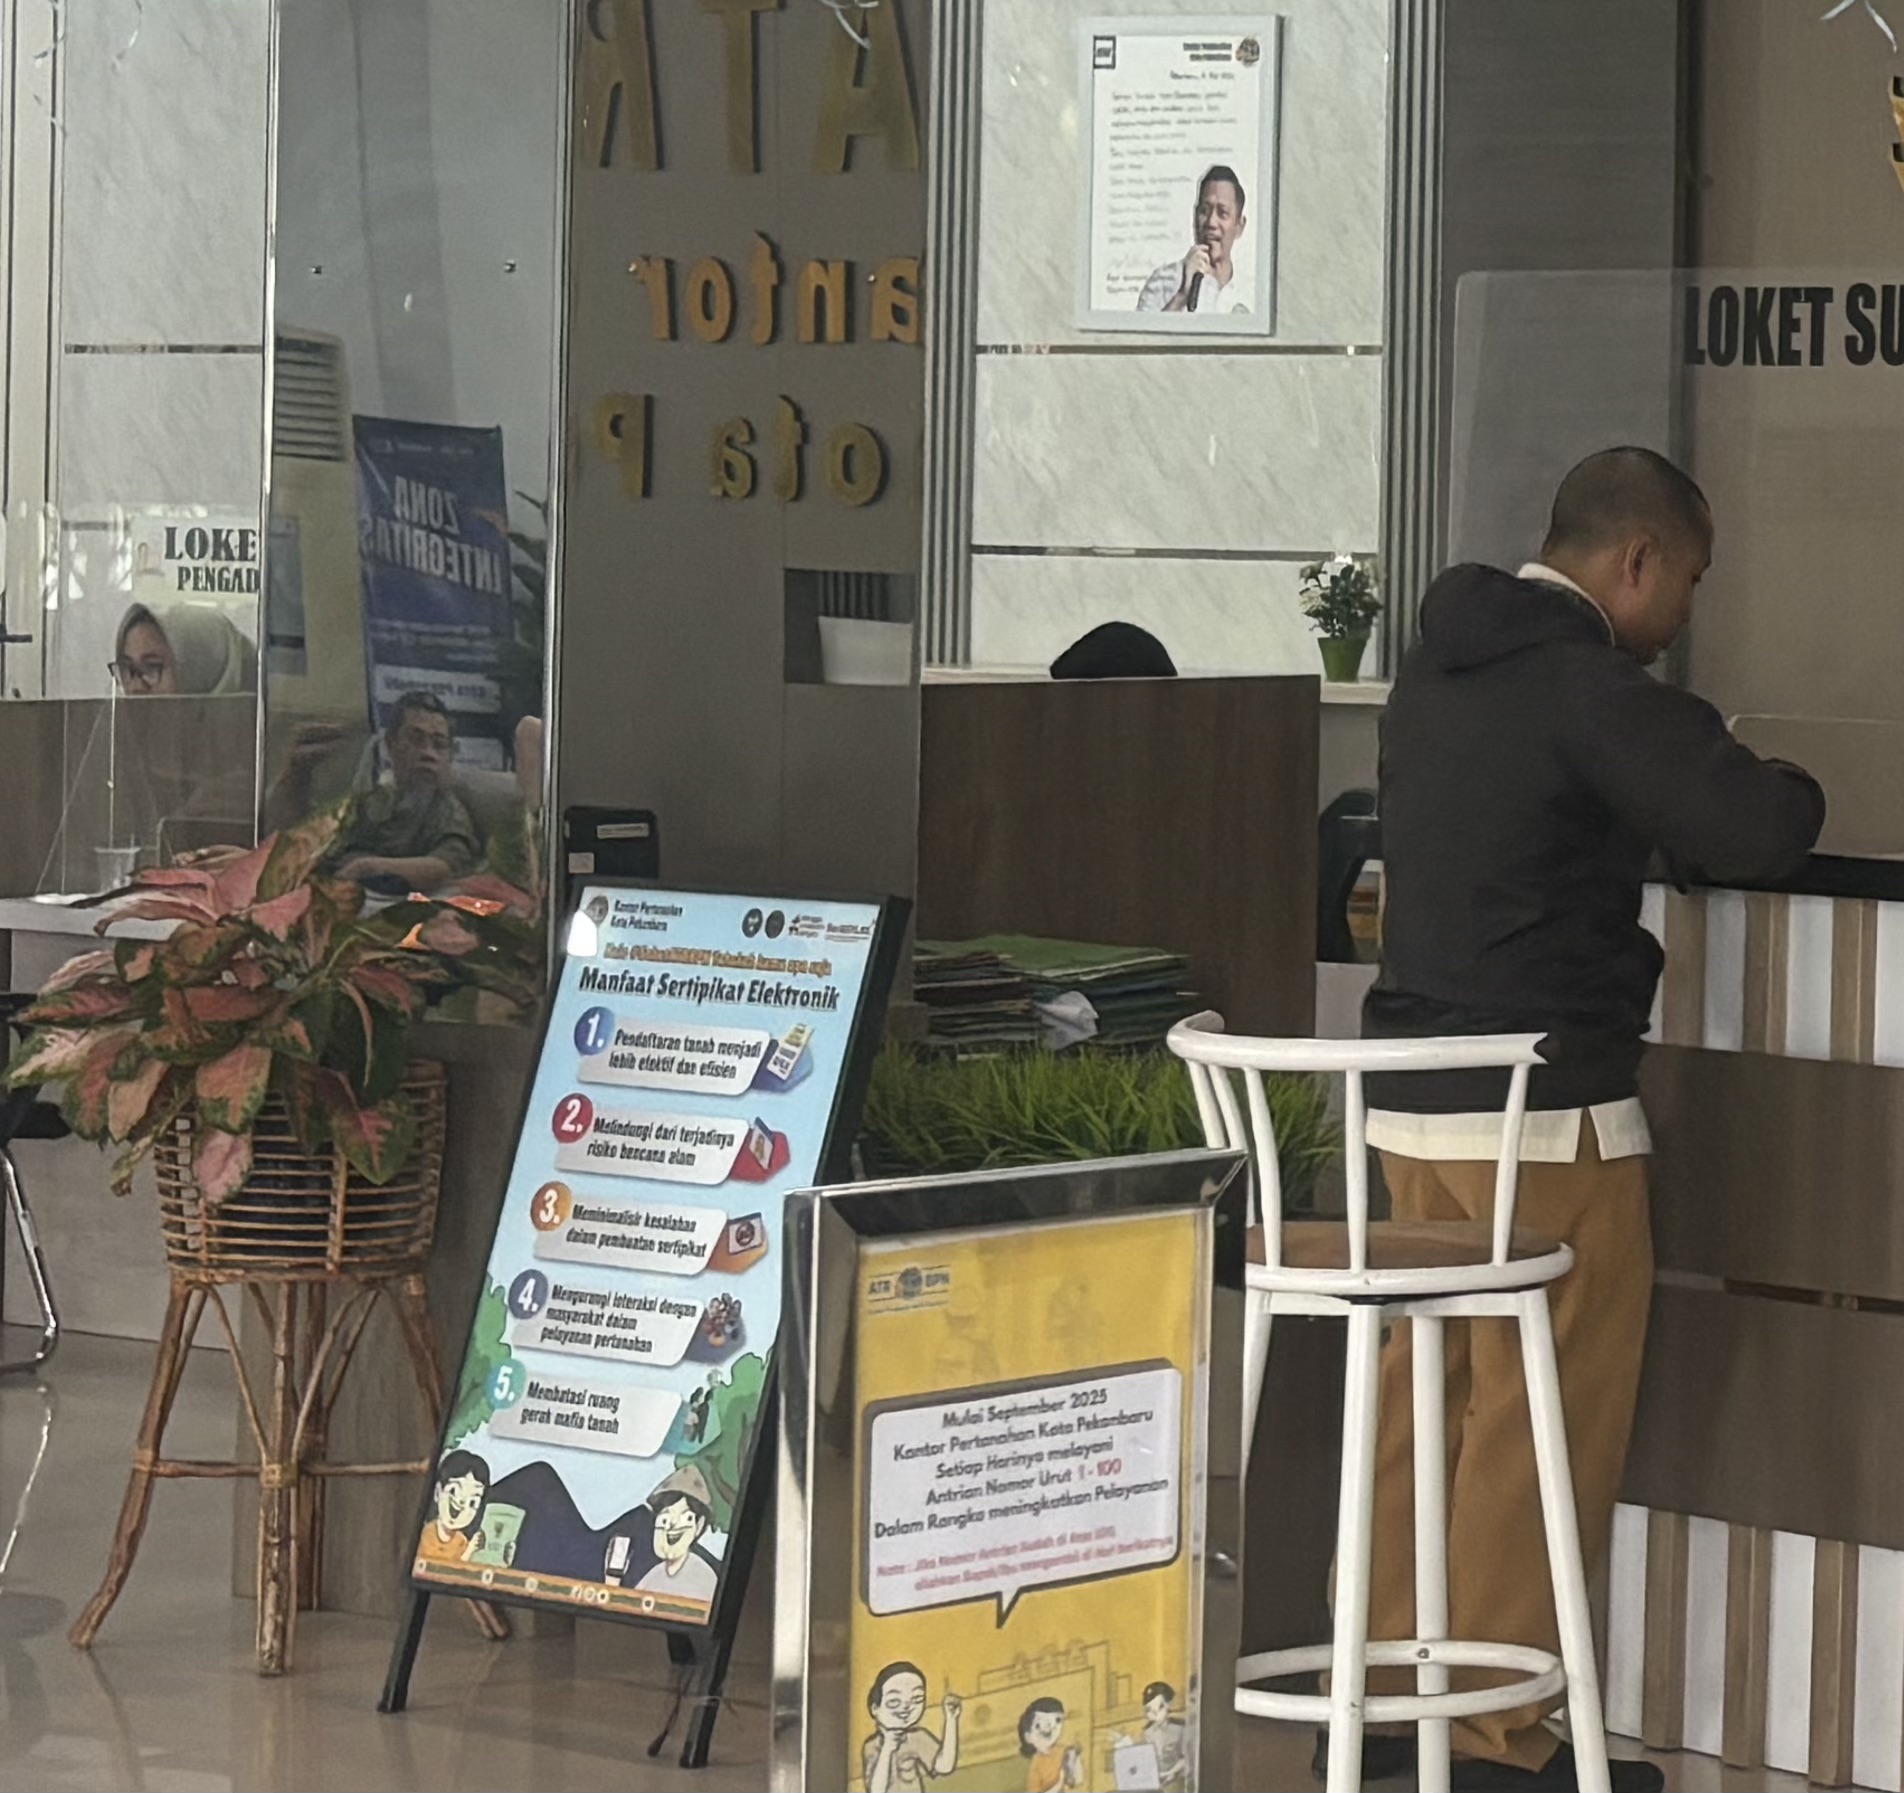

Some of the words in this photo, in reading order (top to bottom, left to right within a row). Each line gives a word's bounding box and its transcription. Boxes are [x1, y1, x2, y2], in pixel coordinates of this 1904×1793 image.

[1685, 285, 1833, 367] LOKET
[580, 966, 654, 994] Manfaat
[657, 972, 744, 1006] Sertipikat
[748, 979, 840, 1009] Elektronik
[585, 1012, 605, 1047] 1.
[614, 1029, 681, 1050] Pendaftaran
[942, 1411, 984, 1428] Mulai
[987, 1398, 1066, 1421] September
[1070, 1388, 1108, 1406] 2025
[894, 1441, 945, 1461] Kantor
[950, 1428, 1034, 1452] Pertanahan
[1077, 1410, 1153, 1432] Pekanbaru
[875, 1520, 924, 1538] Dalam
